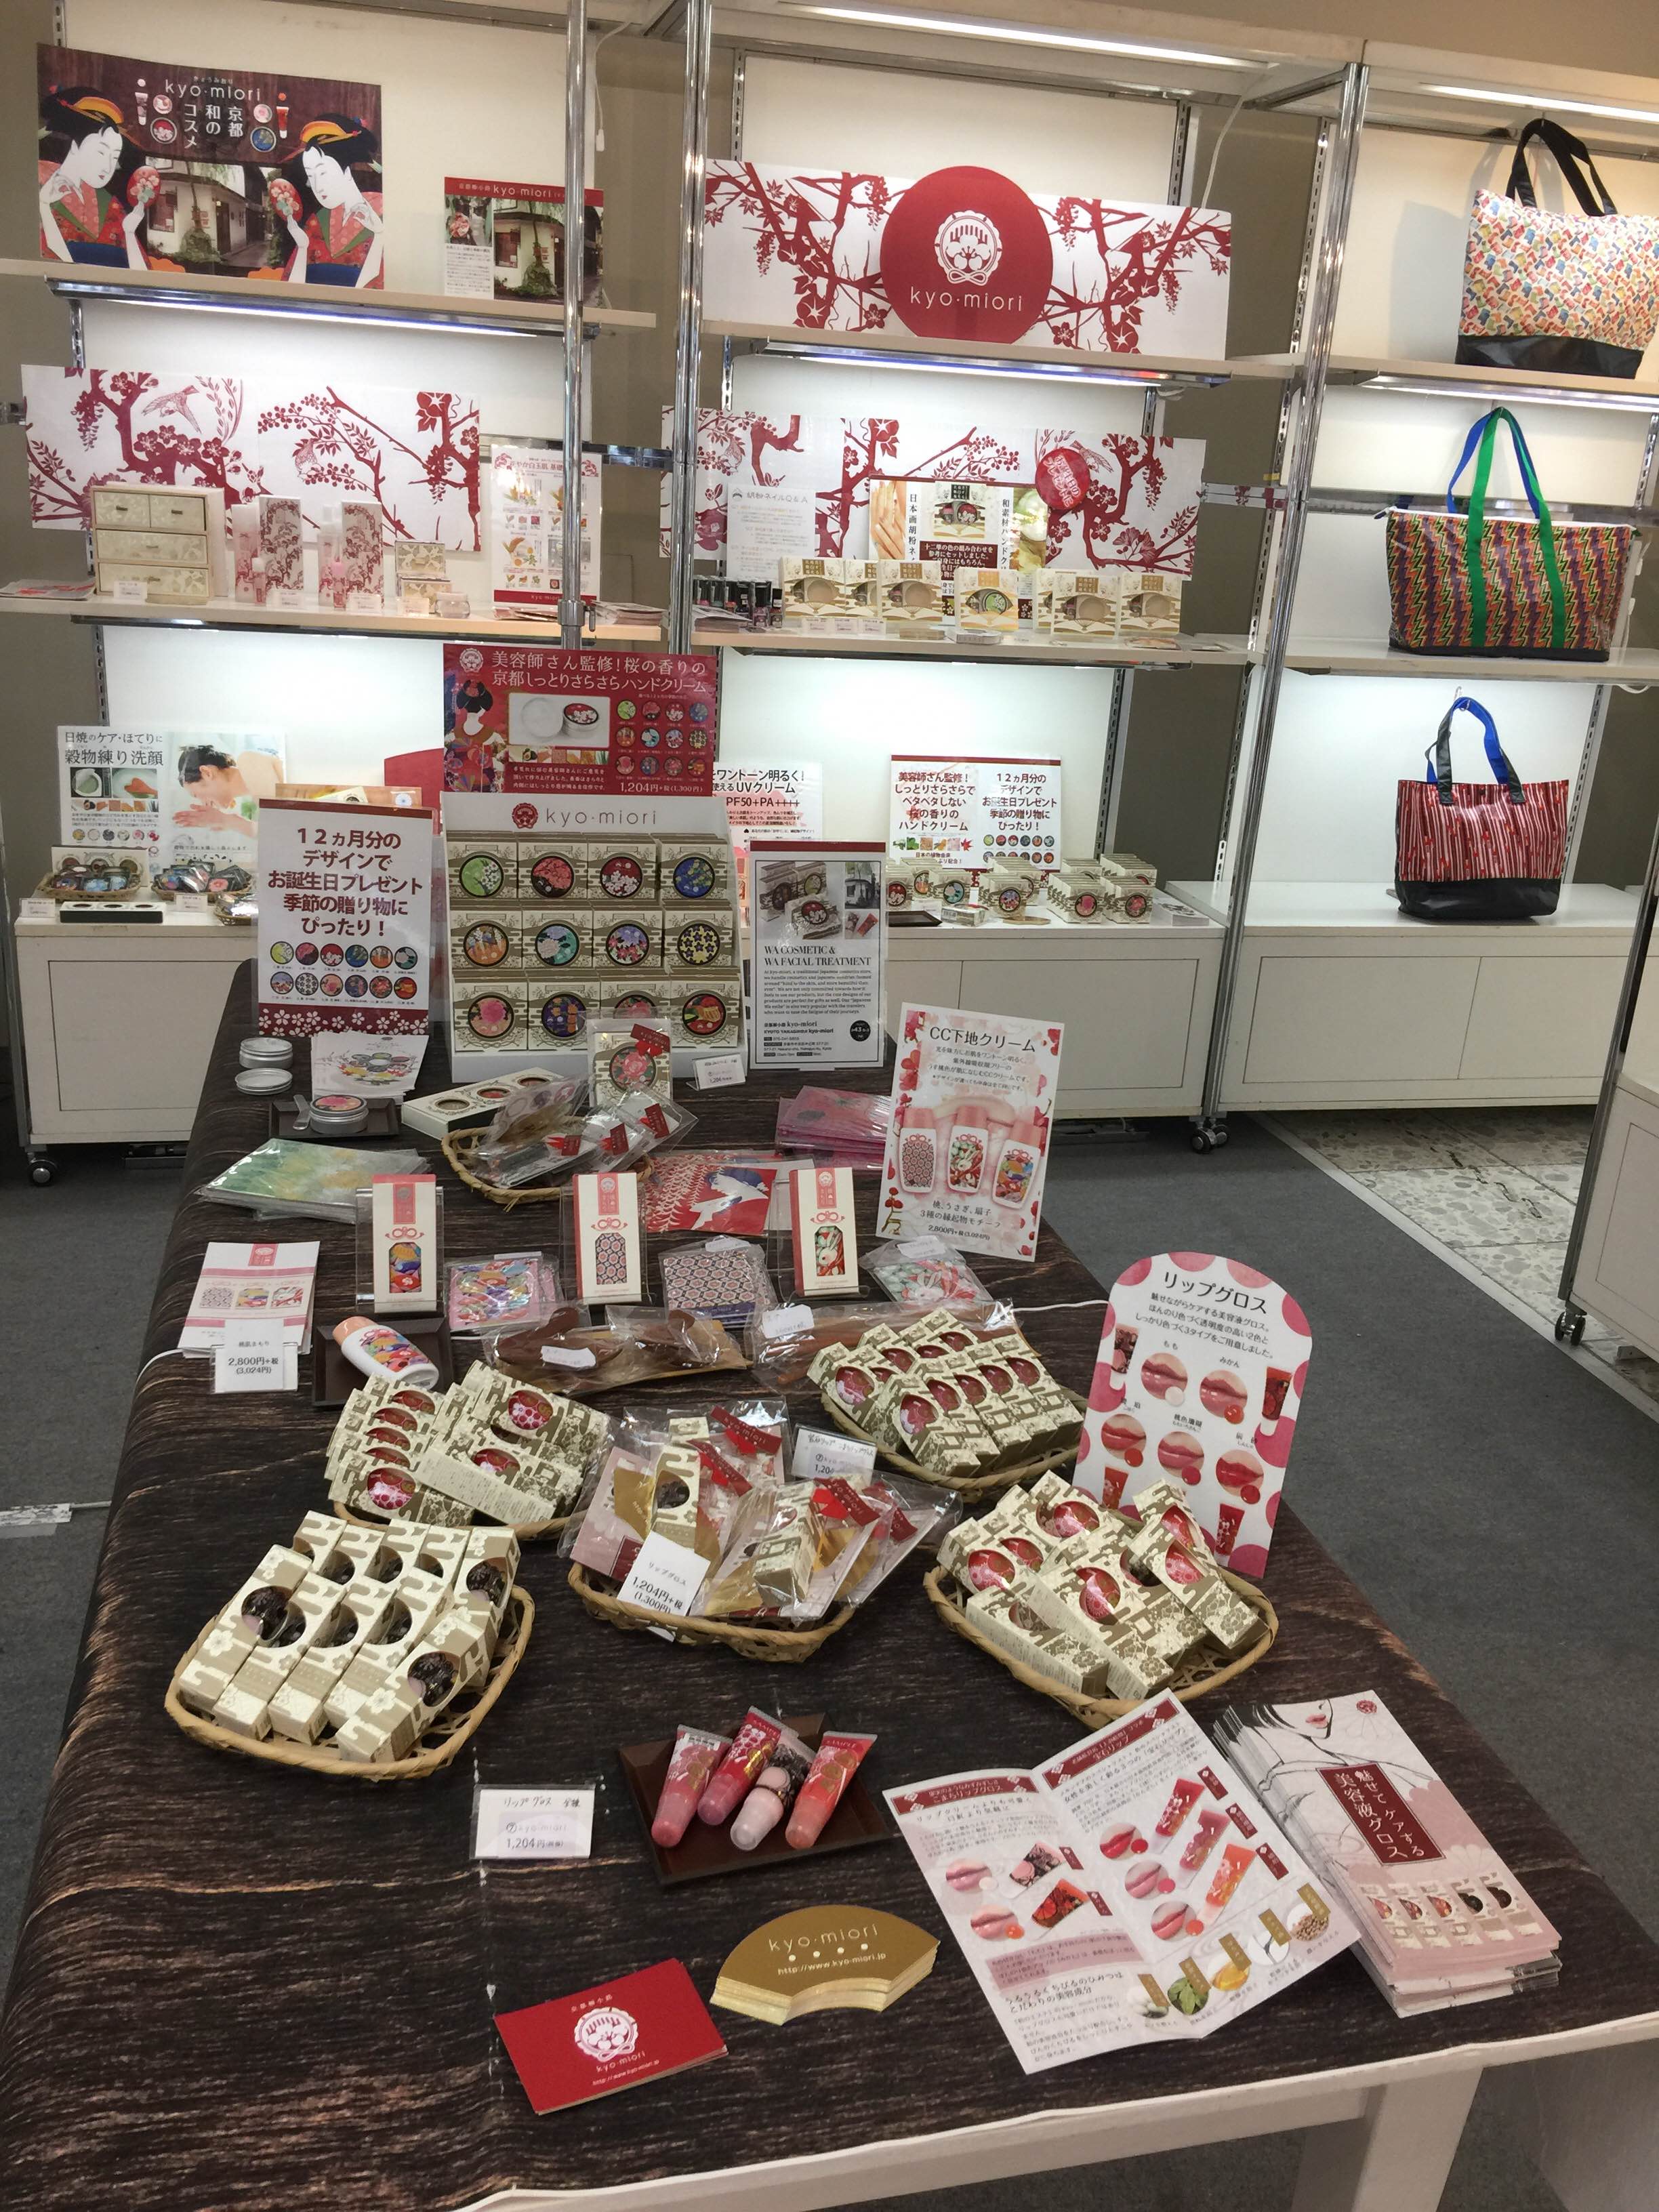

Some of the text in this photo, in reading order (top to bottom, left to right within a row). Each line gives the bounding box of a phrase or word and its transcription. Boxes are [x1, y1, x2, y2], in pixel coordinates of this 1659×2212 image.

[184, 103, 198, 149] コスメ
[205, 104, 221, 135] 和の
[227, 106, 244, 138] 京都
[924, 544, 994, 554] 十二単の色の組み合わせを
[492, 669, 707, 693] 京都しっとりさらさらハンドクリーム
[65, 750, 164, 766] 穀物練り洗顔
[895, 785, 976, 795] しっとりさらさらで
[903, 796, 966, 807] ベタベタしない
[989, 808, 1050, 819] 季節の贈り物に
[899, 821, 968, 832] ハンドクリーム
[304, 850, 393, 872] デザインで
[268, 870, 424, 896] お誕生日プレゼント
[284, 893, 408, 916] 季節の贈り物に
[764, 946, 836, 954] WA COSMETIC &
[764, 957, 872, 966] WA FACIAL TREATMENT
[930, 1026, 1036, 1052] CC下地クリーム
[1164, 1271, 1267, 1315] リップグロス
[1151, 1292, 1269, 1332] 魅せながらケアする美容液グロス。
[1135, 1312, 1273, 1359] しっかり色づく3タイプをご用意しました。
[1149, 1304, 1268, 1345] ほんのり色づく透明度の高い2色と
[1164, 1340, 1179, 1351] もも
[1220, 1356, 1240, 1368] みかん
[1334, 1772, 1409, 1859] 美容液グロス
[1354, 1768, 1426, 1858] 魅せてケアする
[1009, 1986, 1092, 2014] こだわりの美容成分
